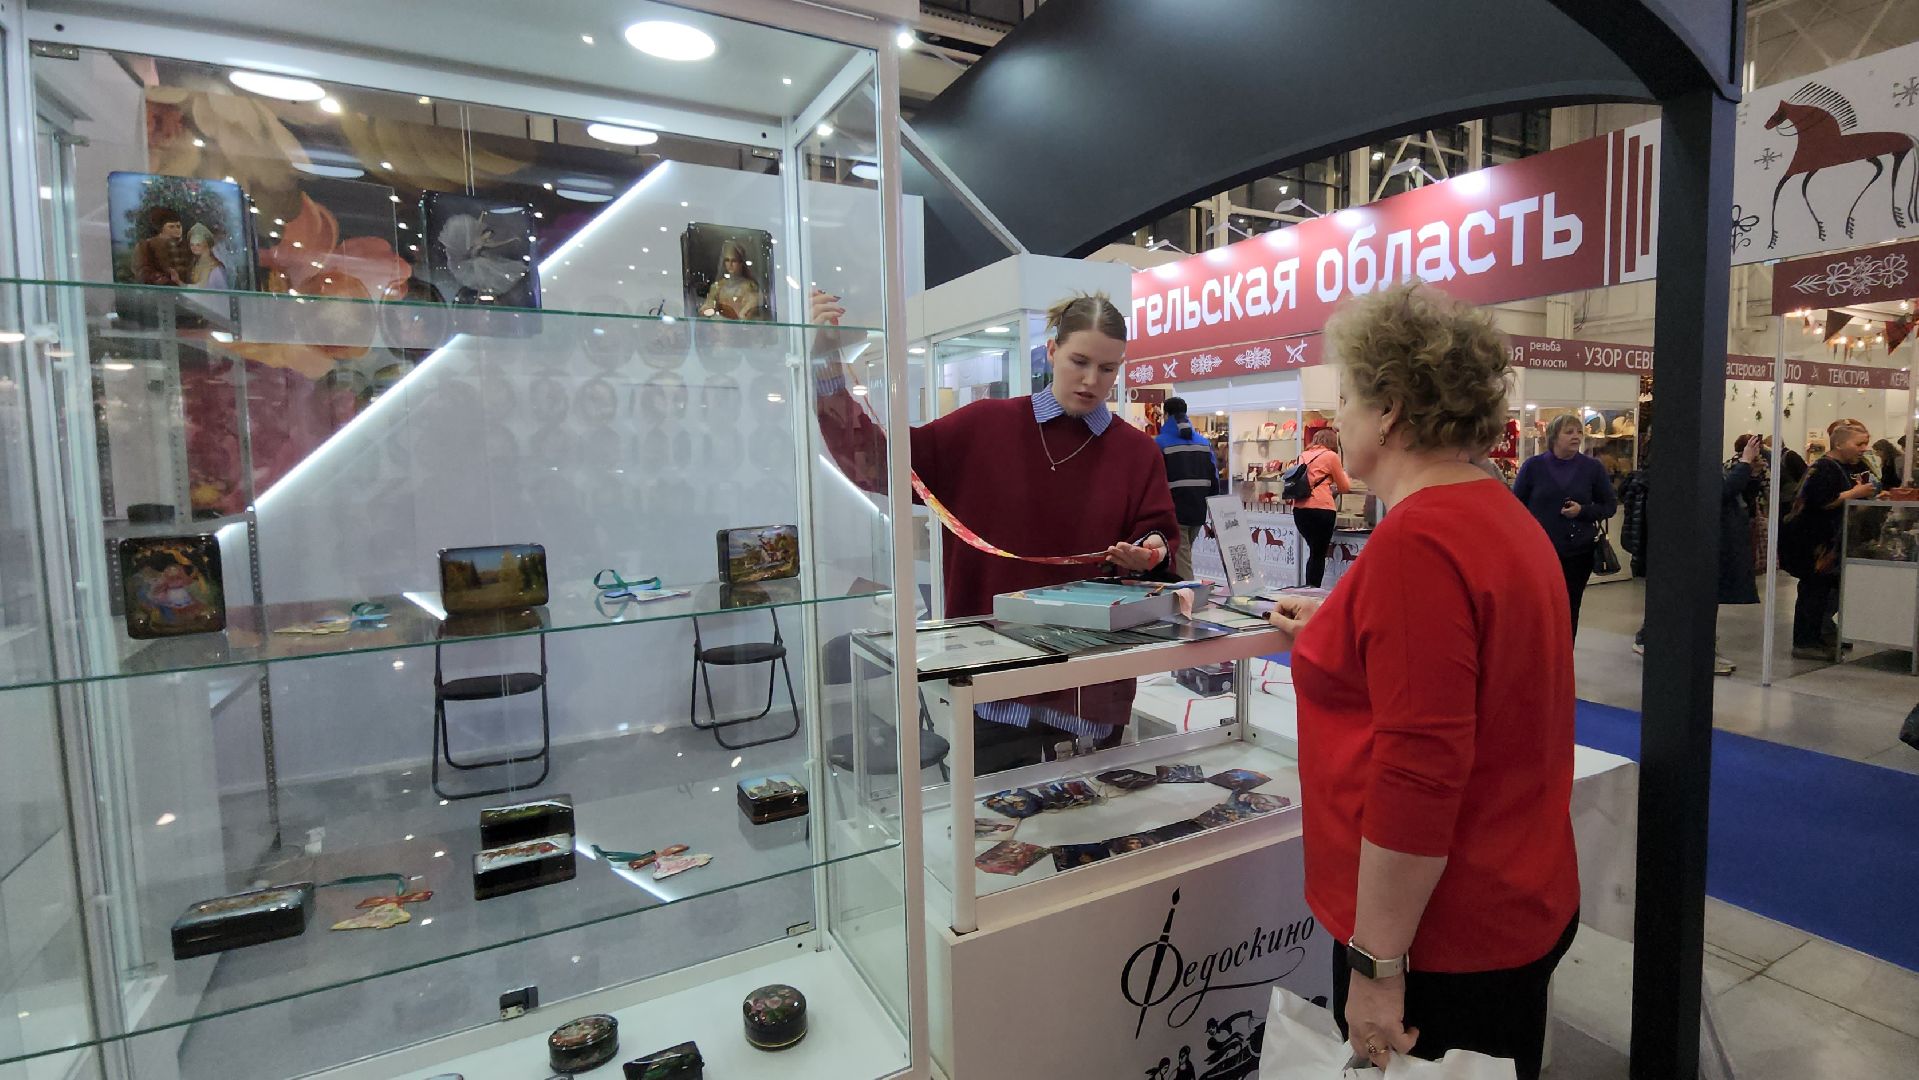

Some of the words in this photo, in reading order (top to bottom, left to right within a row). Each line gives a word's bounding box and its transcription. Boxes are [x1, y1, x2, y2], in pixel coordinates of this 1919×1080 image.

[1316, 191, 1583, 303] область
[1529, 340, 1562, 352] резьба
[1529, 358, 1541, 367] по
[1542, 357, 1568, 369] кости
[1584, 346, 1622, 368] УЗОР
[1725, 362, 1767, 379] астерская
[1827, 367, 1871, 385] ТЕКСТУРА
[1889, 371, 1911, 387] КЕРА
[1120, 886, 1315, 1040] Федоскино
